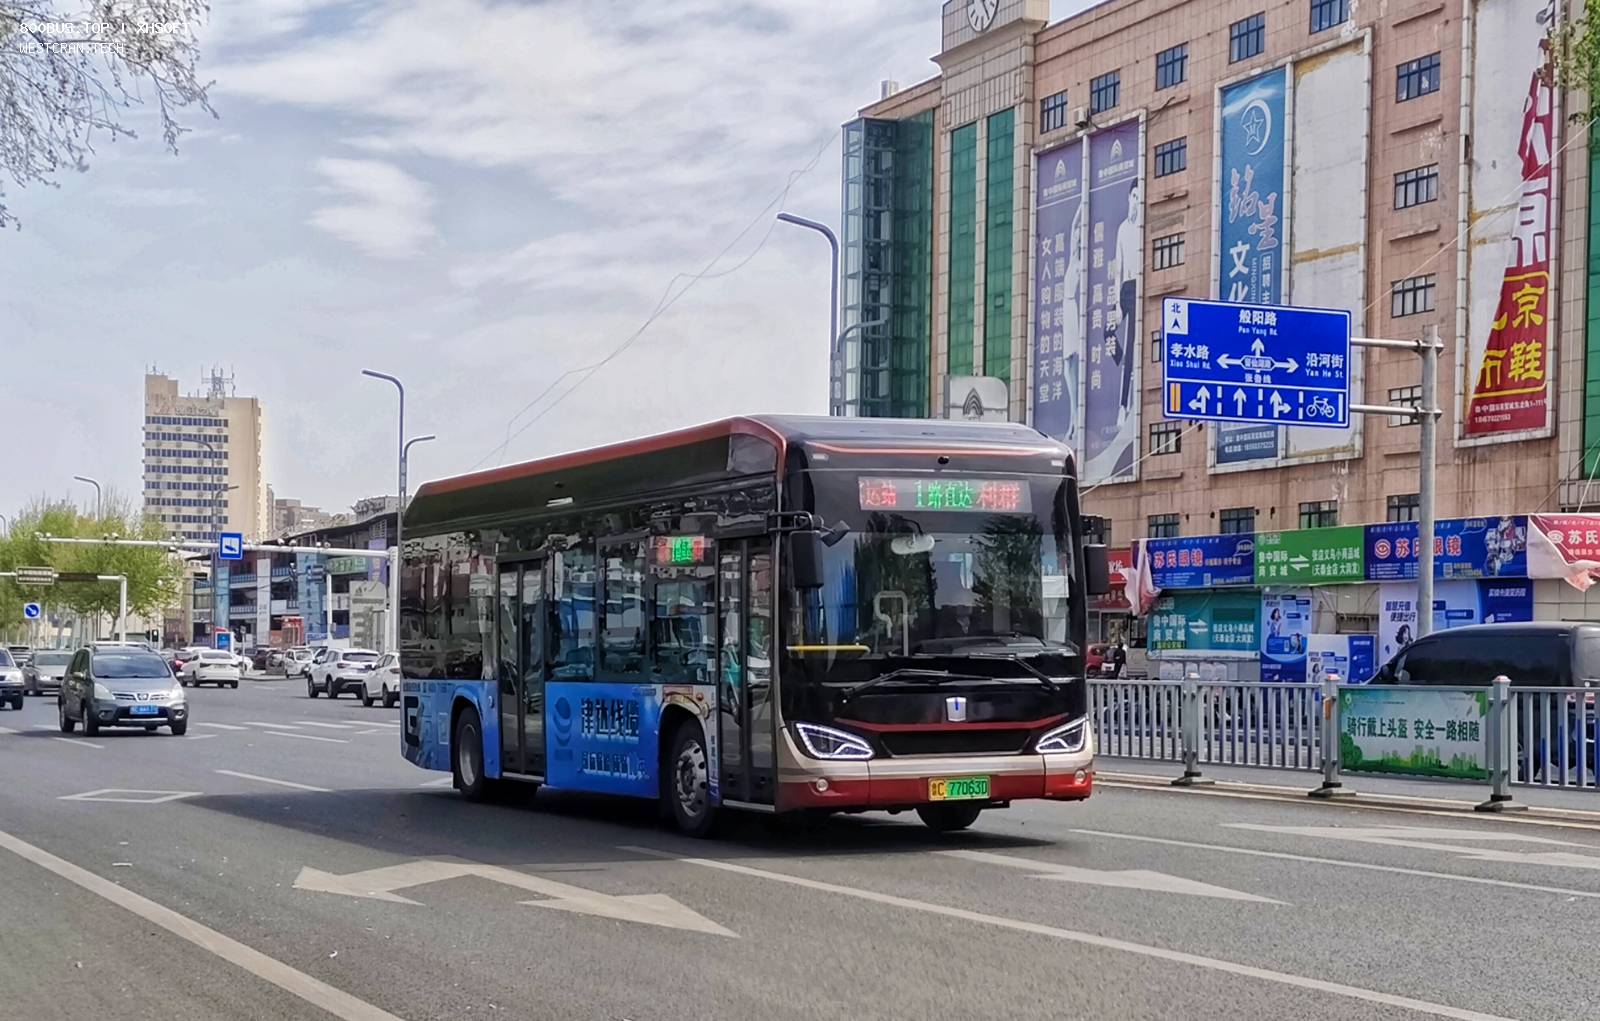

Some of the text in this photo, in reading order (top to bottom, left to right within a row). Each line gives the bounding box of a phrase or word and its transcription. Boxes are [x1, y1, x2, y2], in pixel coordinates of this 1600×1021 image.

[1171, 303, 1181, 313] 北
[1491, 283, 1545, 331] 京
[1238, 309, 1278, 326] 般阳路
[1170, 342, 1210, 360] 孝水路
[1305, 353, 1344, 369] 沿河街
[1347, 716, 1480, 742] 骑行戴上头盔 安全一路相随
